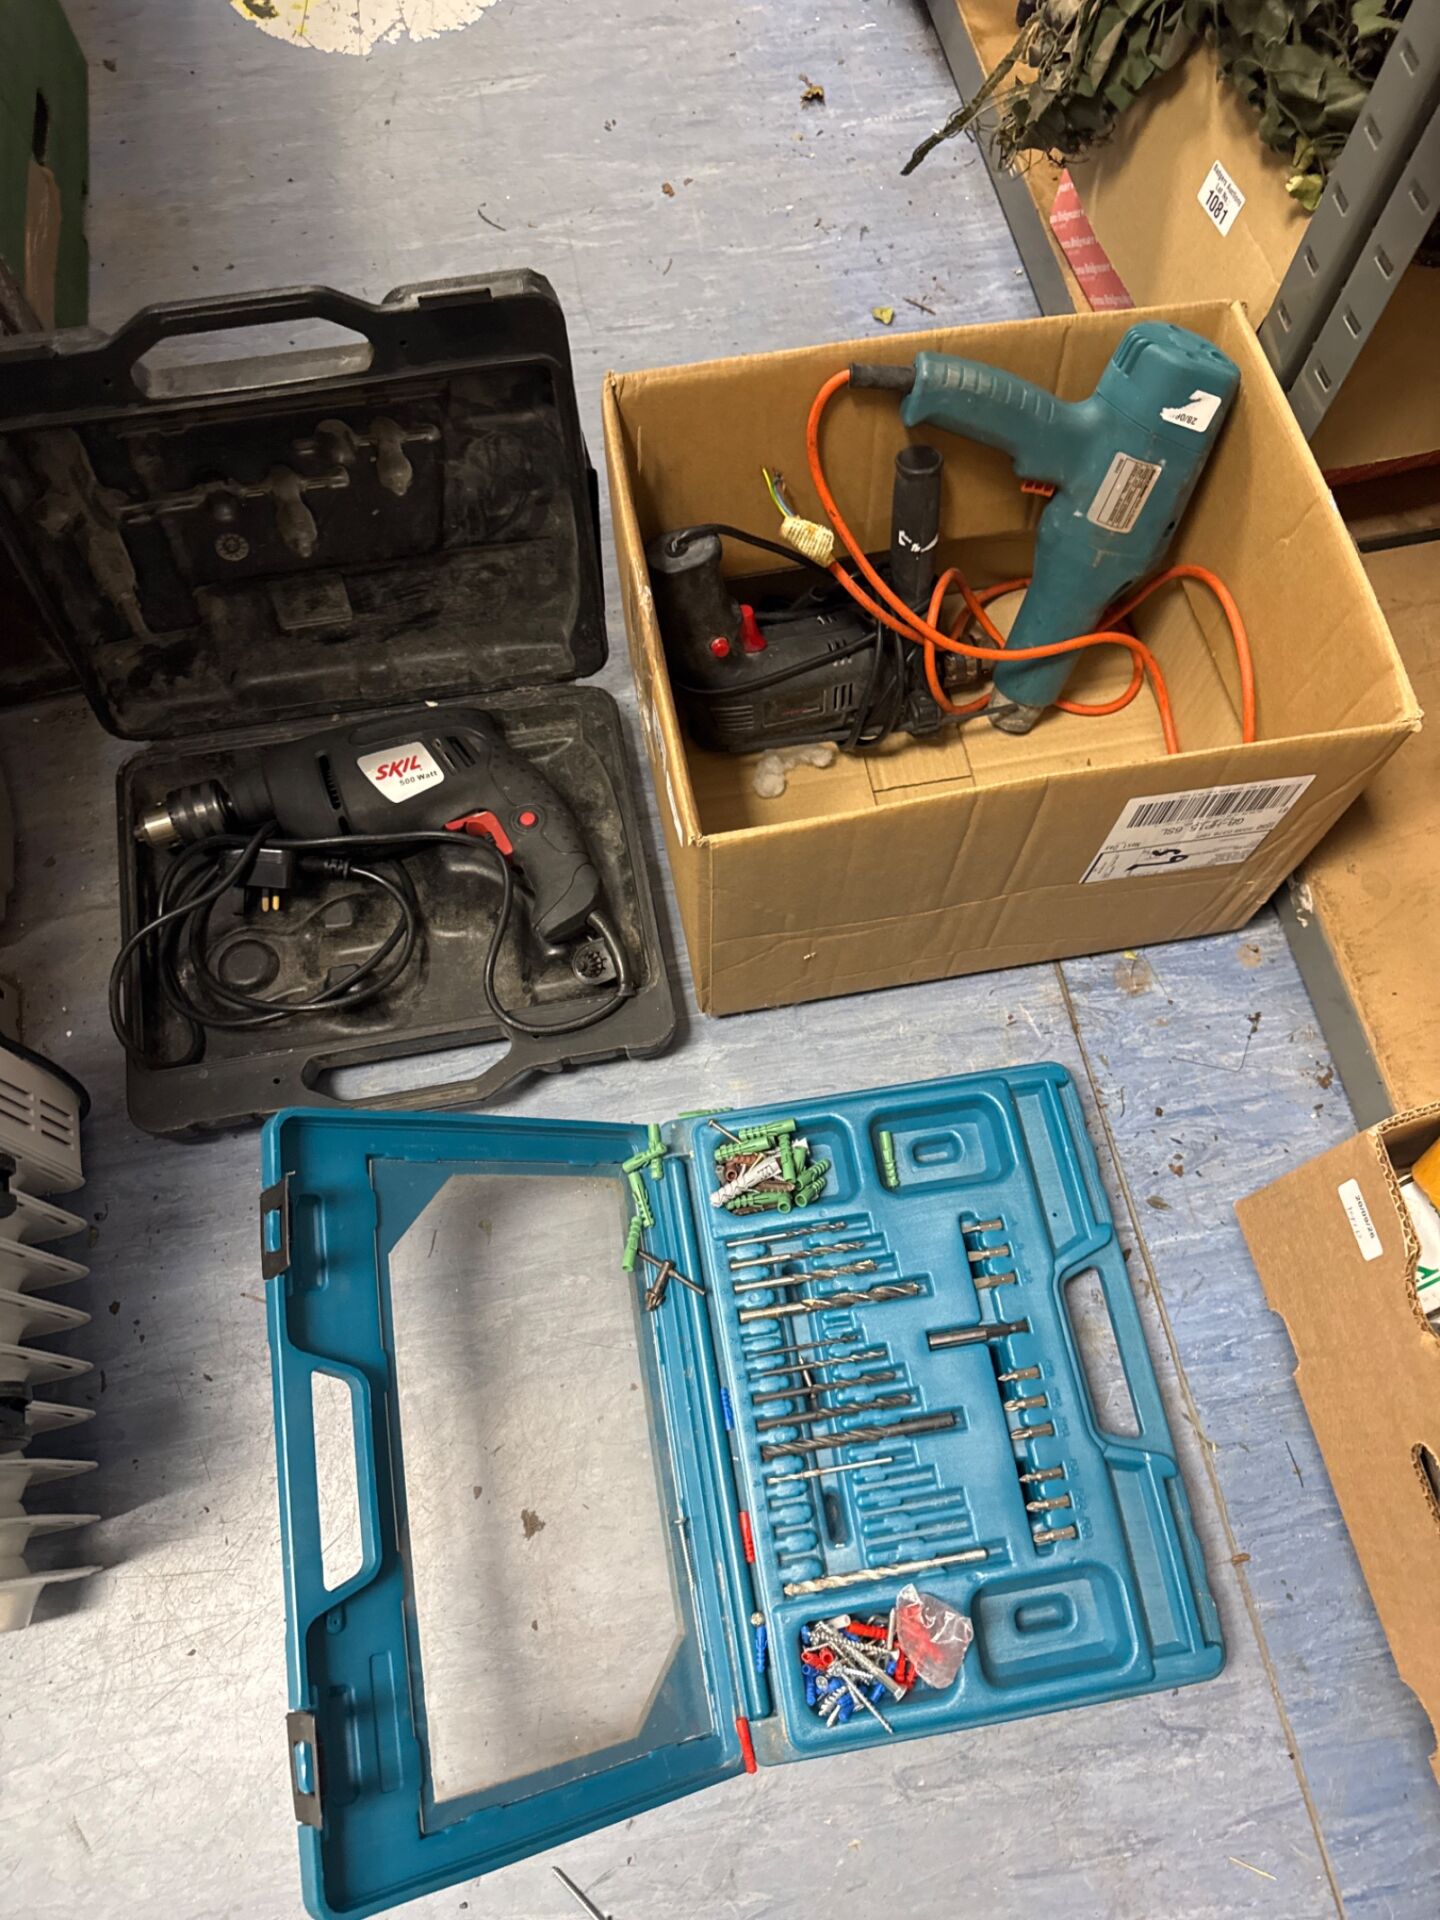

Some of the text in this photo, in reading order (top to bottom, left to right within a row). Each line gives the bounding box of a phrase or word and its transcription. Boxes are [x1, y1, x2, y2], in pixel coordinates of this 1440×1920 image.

[1205, 189, 1228, 225] 1081
[376, 755, 421, 780] SKIL
[399, 770, 438, 786] 500 Watt
